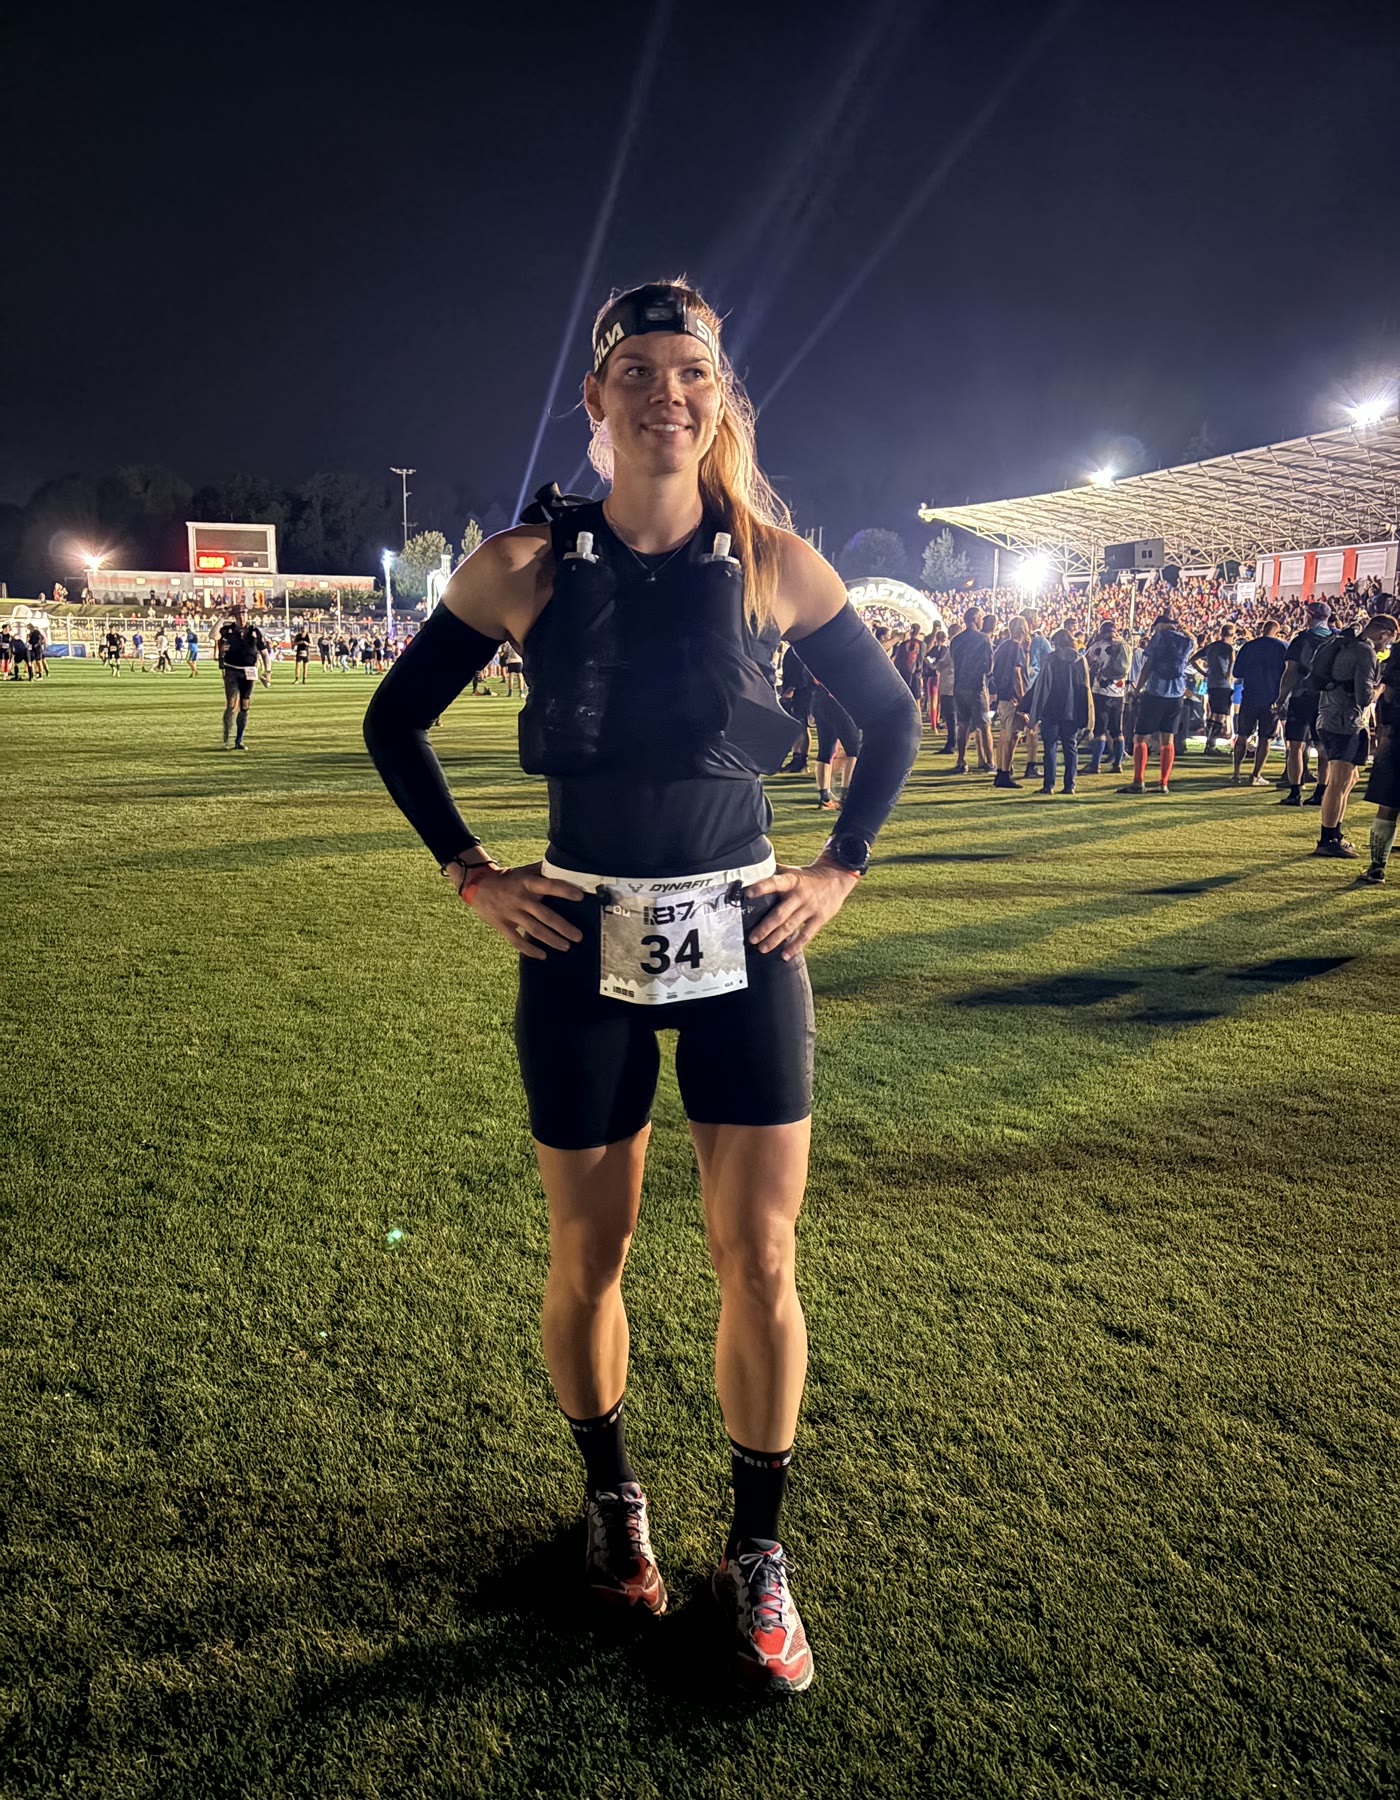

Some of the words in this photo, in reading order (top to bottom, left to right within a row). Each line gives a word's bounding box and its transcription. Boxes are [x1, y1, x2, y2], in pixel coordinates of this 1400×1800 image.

[847, 583, 905, 602] RAFT
[649, 878, 713, 893] DYNAFIT
[640, 928, 704, 975] 34
